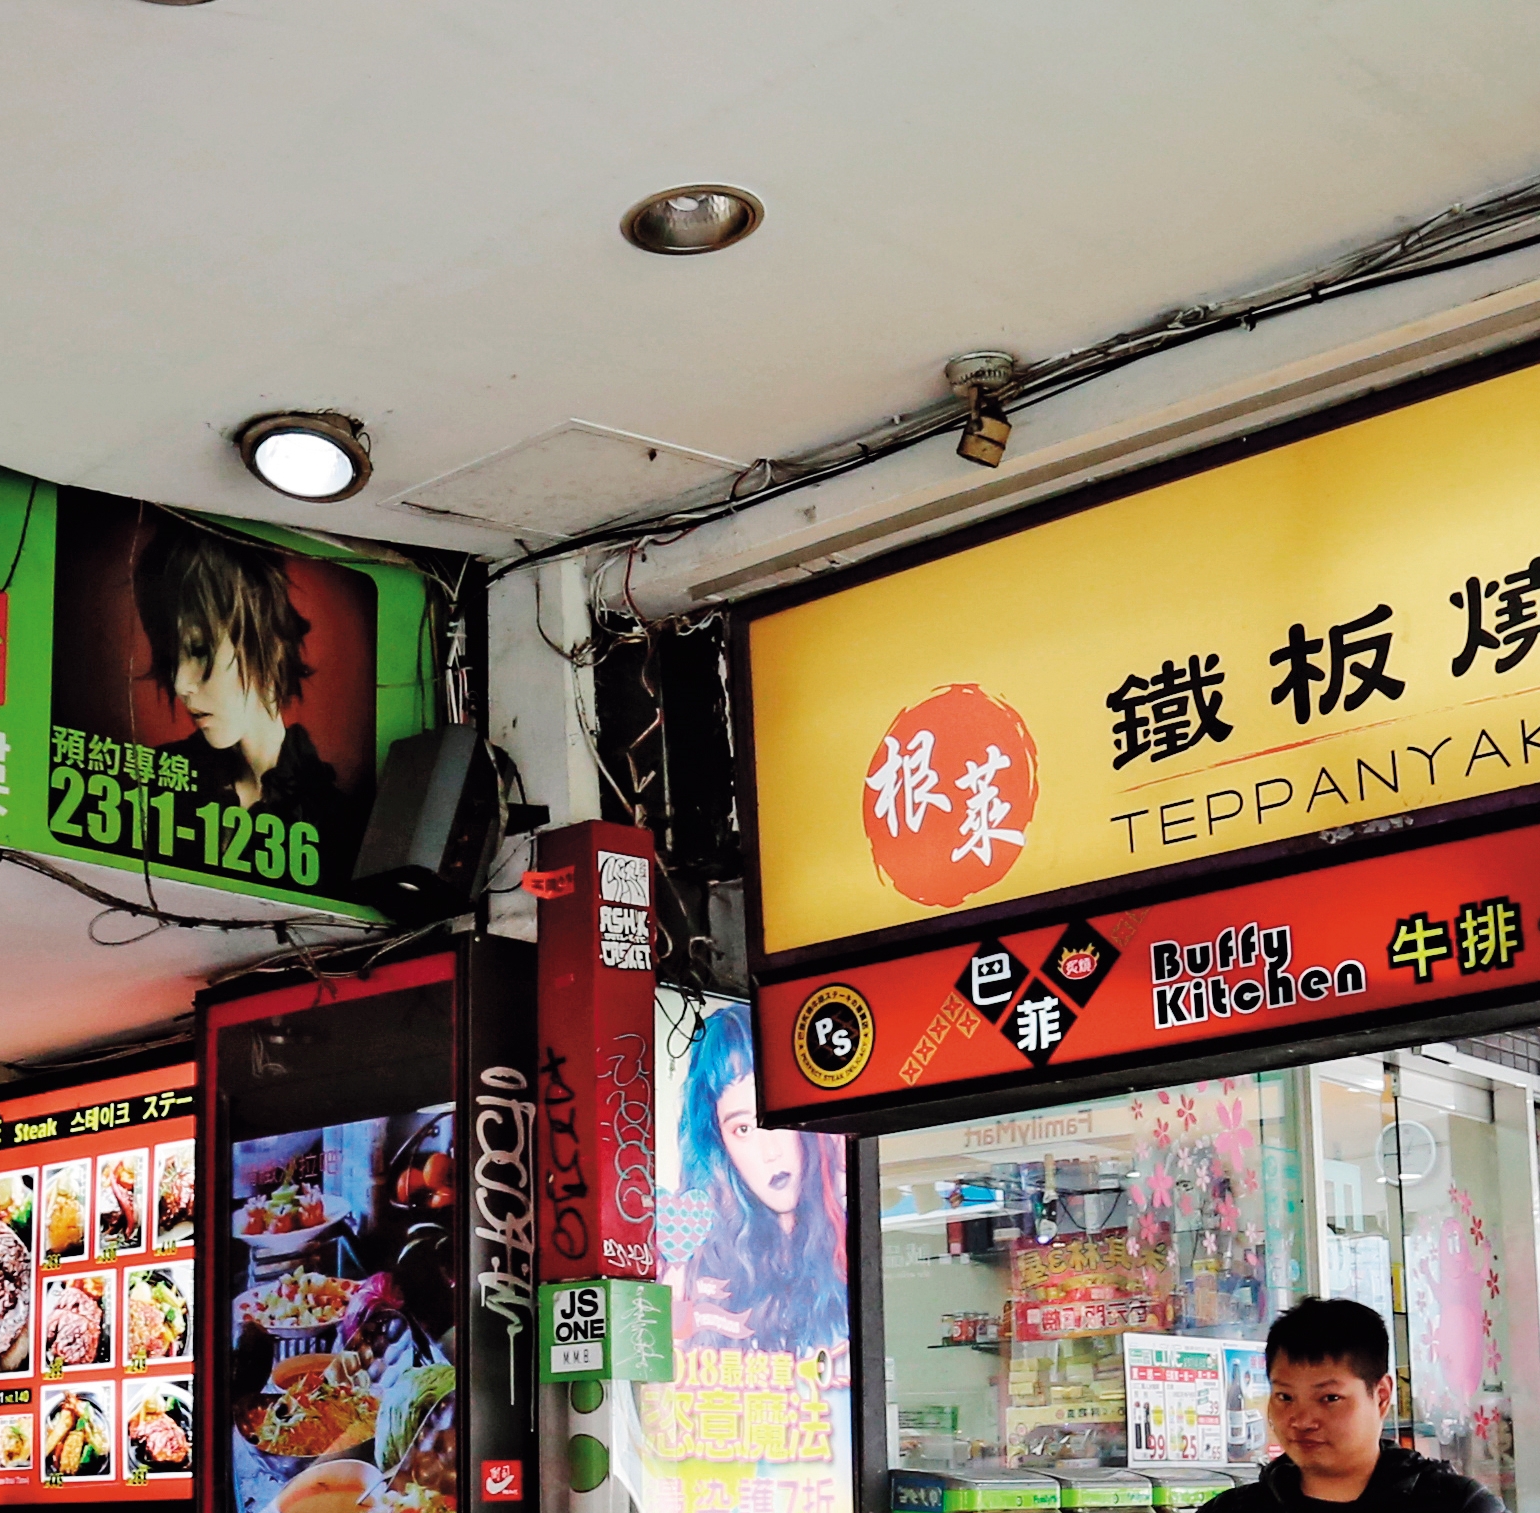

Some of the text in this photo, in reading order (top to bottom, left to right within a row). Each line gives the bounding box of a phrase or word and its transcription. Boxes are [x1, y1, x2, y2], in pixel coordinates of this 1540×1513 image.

[49, 765, 321, 888] 2311-1236
[970, 951, 1014, 1007] 巴
[1150, 922, 1293, 986] Buffy
[1152, 958, 1368, 1031] Kitchen
[1015, 995, 1062, 1053] 菲
[13, 1117, 58, 1144] Steak
[555, 1318, 606, 1343] ONE
[560, 1288, 599, 1320] JS
[1147, 1433, 1198, 1460] 99 25
